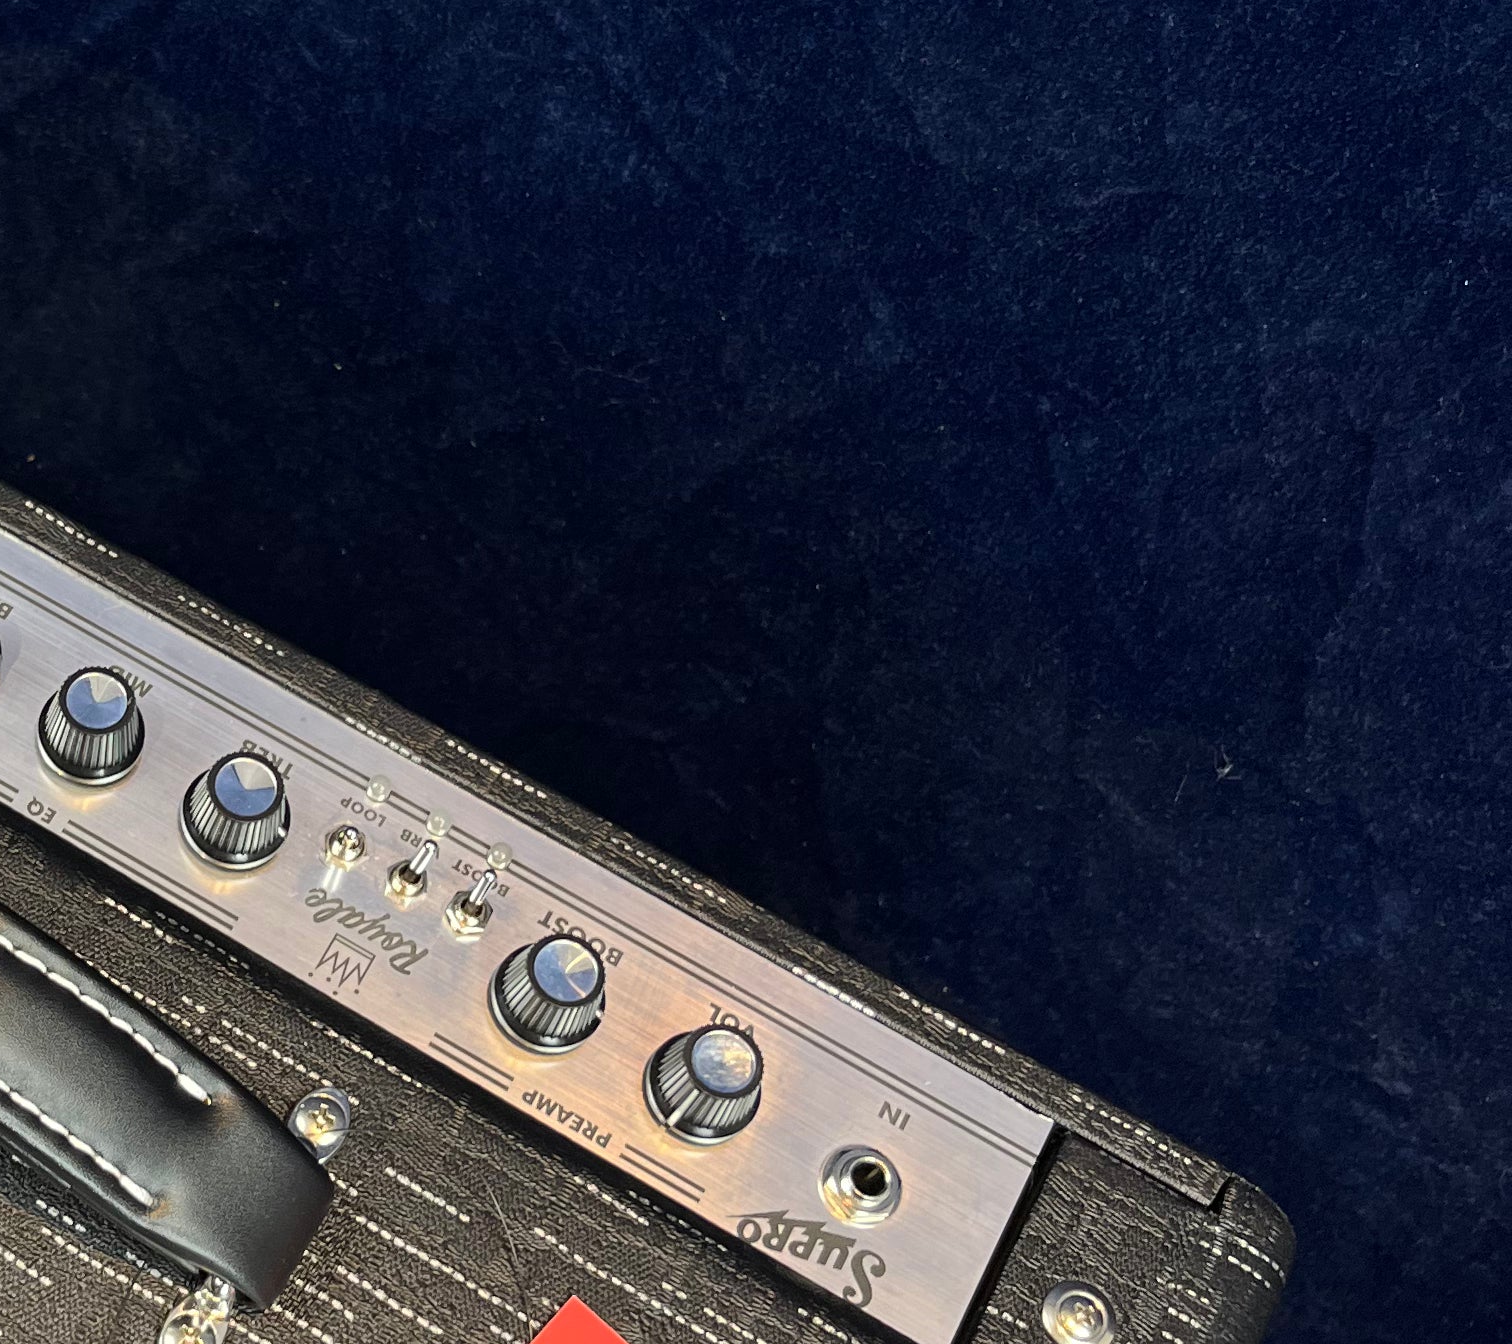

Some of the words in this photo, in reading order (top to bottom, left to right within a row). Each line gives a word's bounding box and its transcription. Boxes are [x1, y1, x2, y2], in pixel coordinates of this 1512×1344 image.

[22, 794, 58, 824] EQ
[338, 793, 386, 827] LOOP
[397, 826, 443, 859] RB
[303, 886, 429, 976] Royale
[518, 1085, 613, 1148] PREAMP
[877, 1100, 911, 1129] IN
